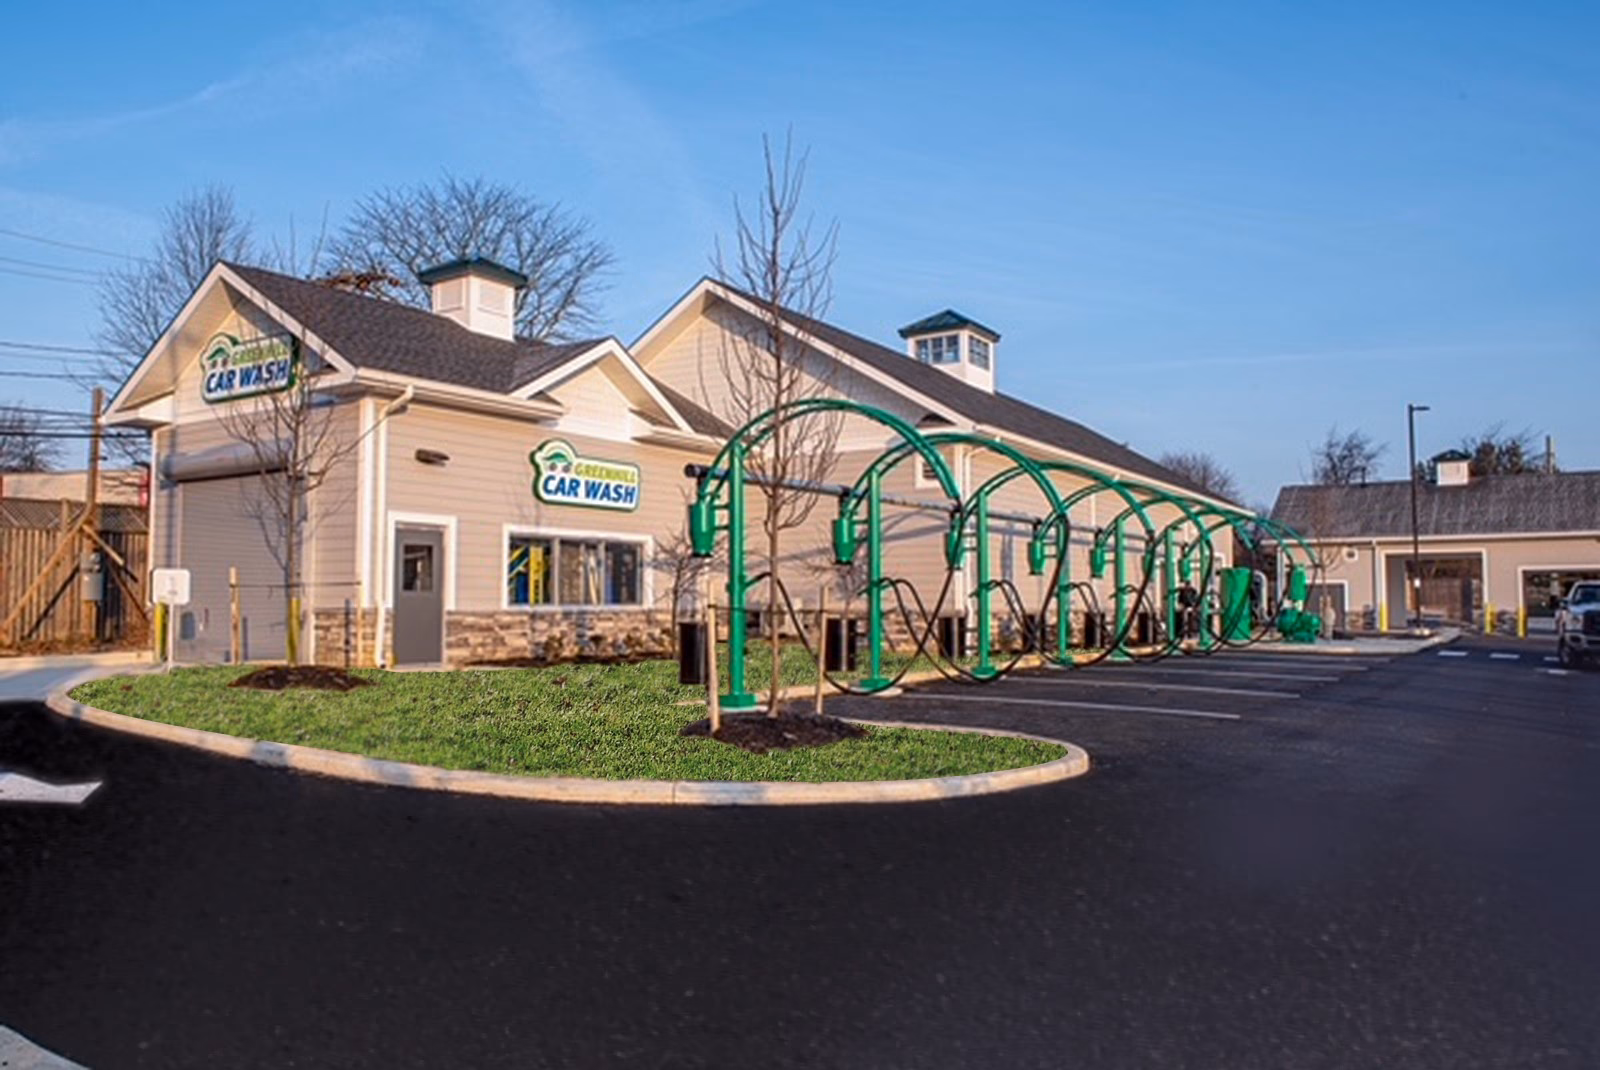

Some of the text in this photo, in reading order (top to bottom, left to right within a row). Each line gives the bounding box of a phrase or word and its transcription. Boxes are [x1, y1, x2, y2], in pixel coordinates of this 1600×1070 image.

[207, 359, 288, 393] CAR WASH
[543, 475, 636, 503] CAR WASH
